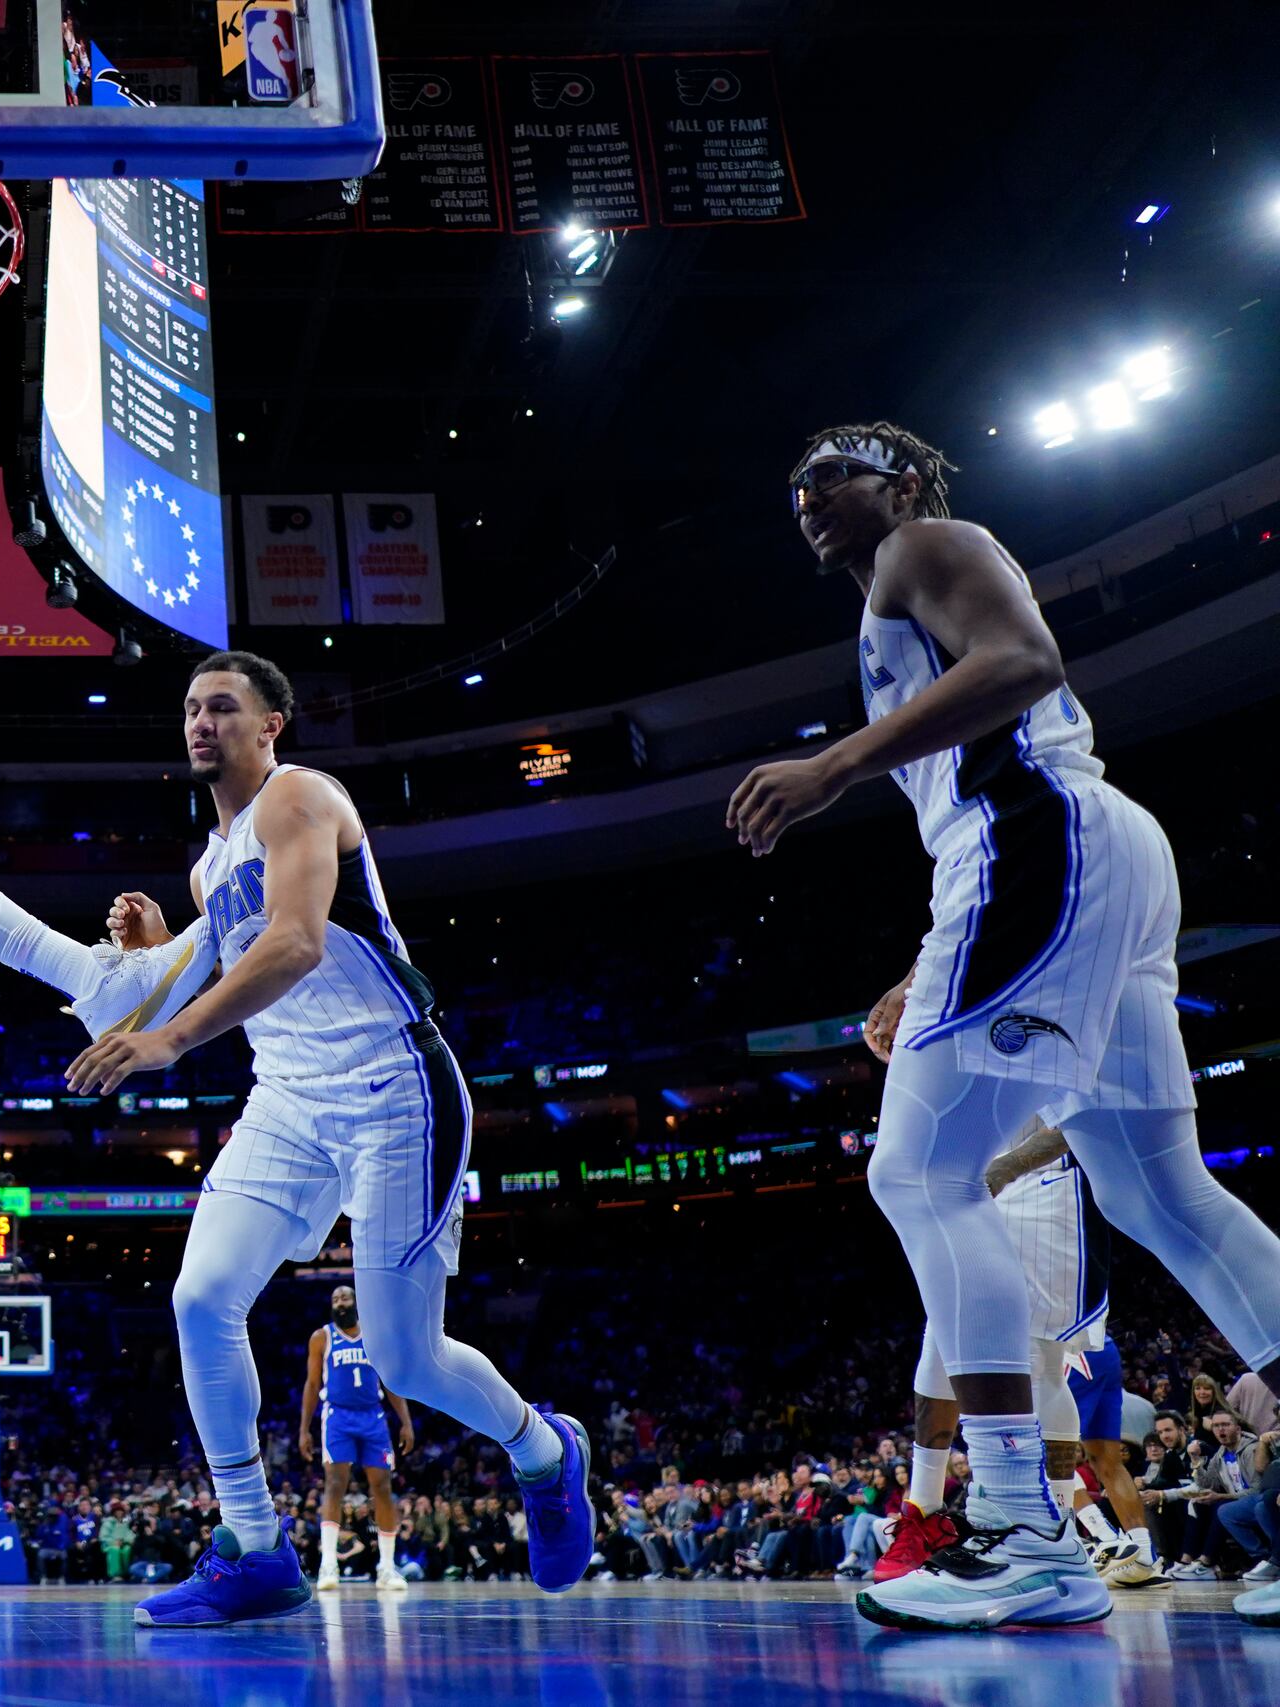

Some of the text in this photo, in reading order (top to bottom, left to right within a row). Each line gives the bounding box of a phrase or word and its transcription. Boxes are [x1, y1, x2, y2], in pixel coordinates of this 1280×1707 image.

[256, 79, 281, 95] NBA
[412, 124, 477, 139] OF FAME
[514, 122, 621, 138] HALL OF FAME
[707, 119, 725, 133] OF
[730, 117, 769, 131] FAME
[568, 141, 629, 154] JOE WATSON
[598, 155, 631, 166] PROPP
[572, 184, 597, 194] DAVE
[703, 198, 726, 207] PAUL
[594, 209, 639, 220] SCHULTZ
[127, 268, 148, 292] TEAM
[172, 321, 187, 336] STL
[110, 353, 123, 370] PTS
[176, 352, 189, 365] TO
[126, 349, 180, 393] TEAM LEADERS
[134, 404, 174, 437] BANCHERO
[190, 439, 197, 450] 2
[135, 418, 175, 452] BANCHERO
[190, 455, 197, 464] 1
[191, 470, 198, 480] 2
[352, 1367, 363, 1388] 1
